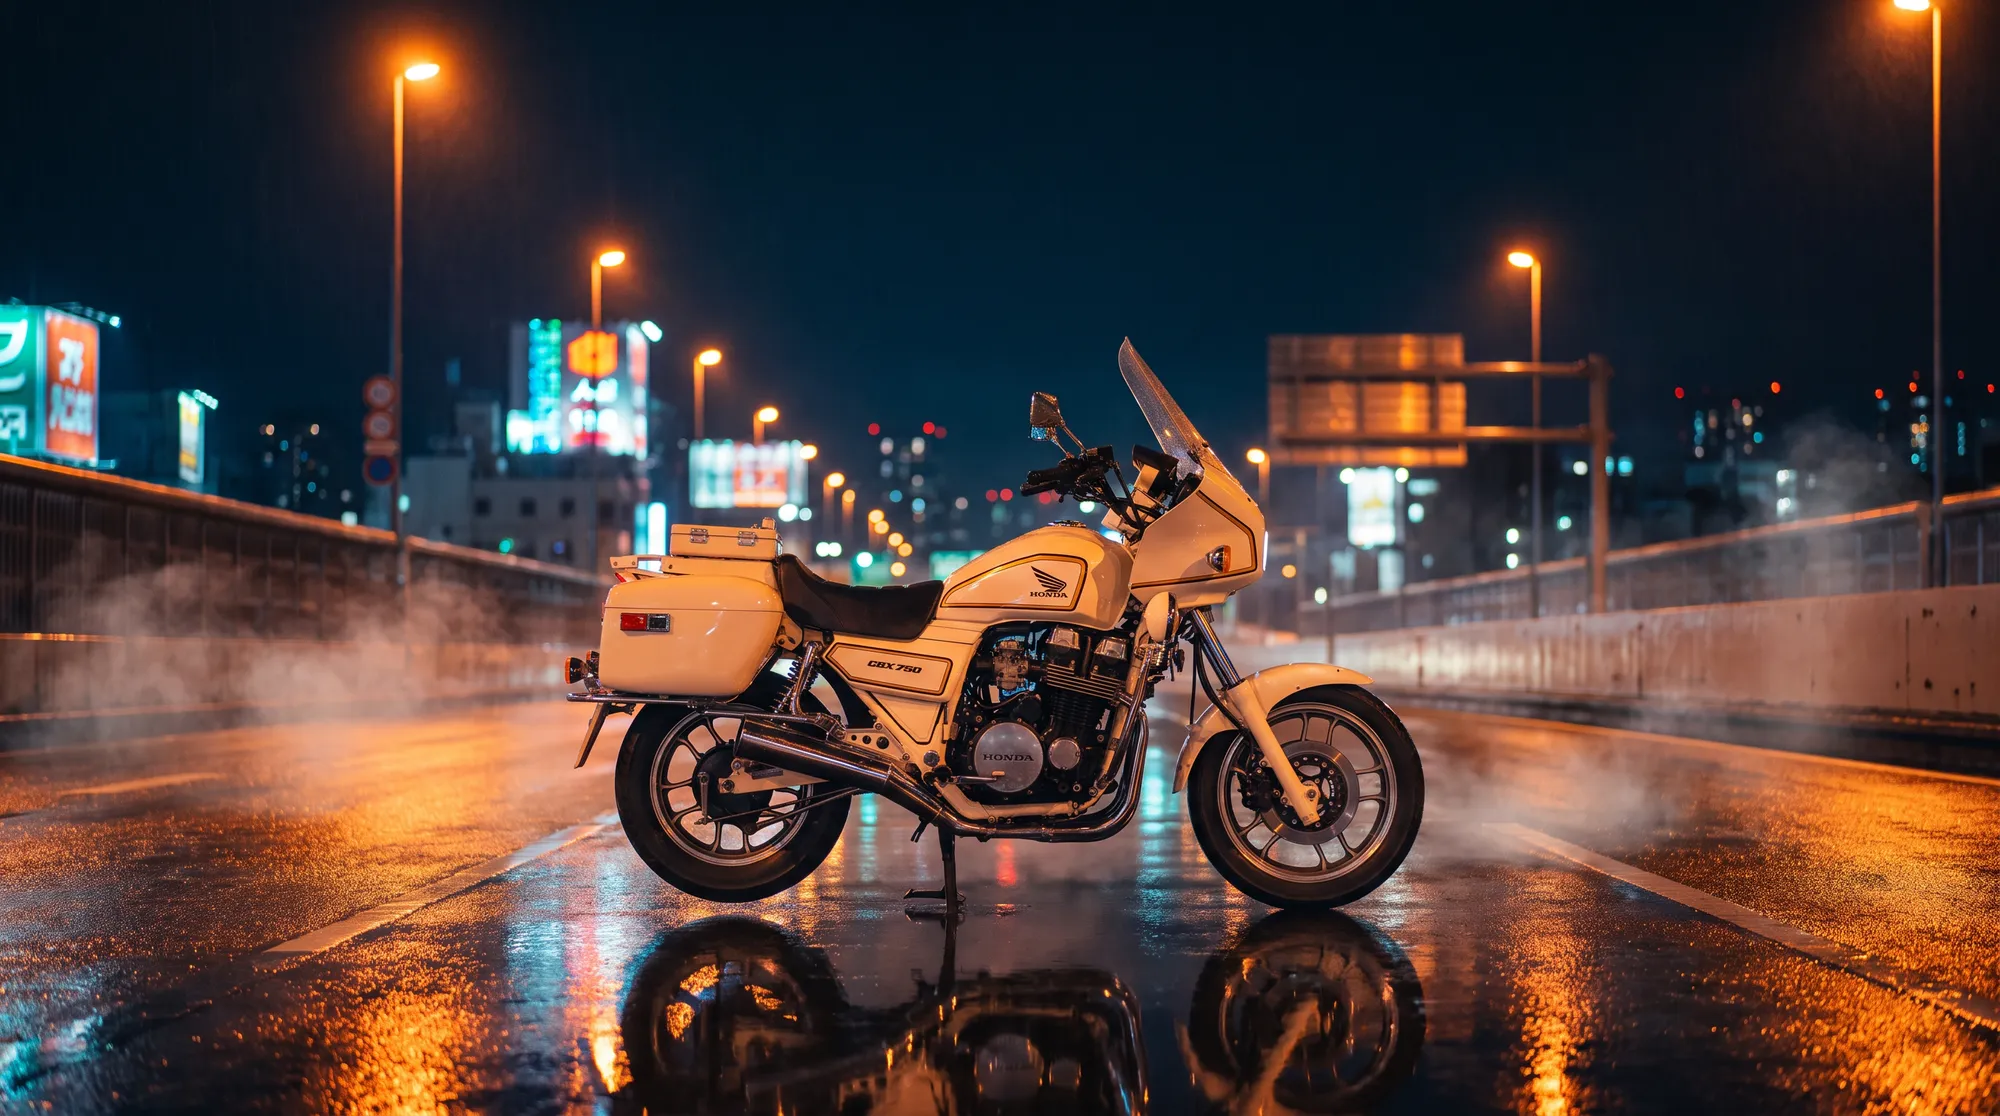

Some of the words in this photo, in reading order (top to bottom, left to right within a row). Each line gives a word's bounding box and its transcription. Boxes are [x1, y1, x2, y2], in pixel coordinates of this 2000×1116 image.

[867, 660, 896, 670] CBX
[895, 664, 922, 673] 750
[983, 753, 1034, 761] HONDA
